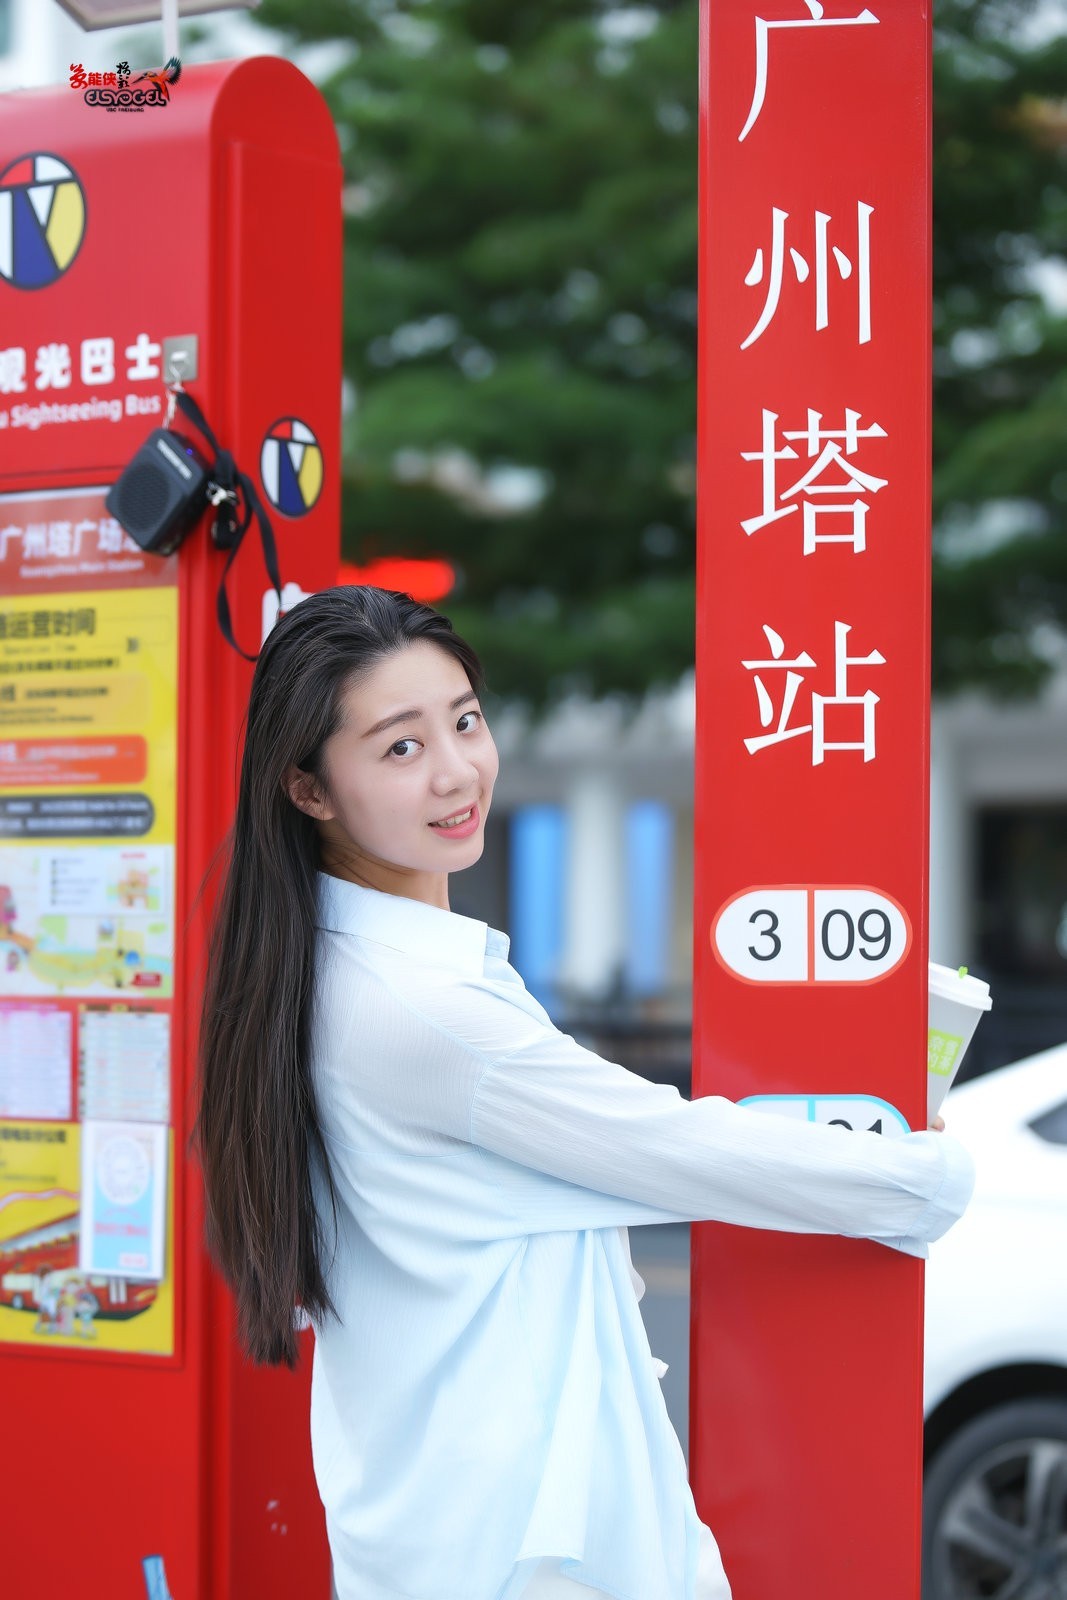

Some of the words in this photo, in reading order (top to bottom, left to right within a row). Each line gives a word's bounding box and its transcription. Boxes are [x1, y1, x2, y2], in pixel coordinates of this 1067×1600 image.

[0, 333, 162, 393] 观光巴士
[737, 0, 889, 767] 广州塔站
[10, 396, 123, 431] Sightseeing
[125, 393, 161, 416] Bus
[748, 909, 782, 961] 3
[821, 909, 892, 961] 09
